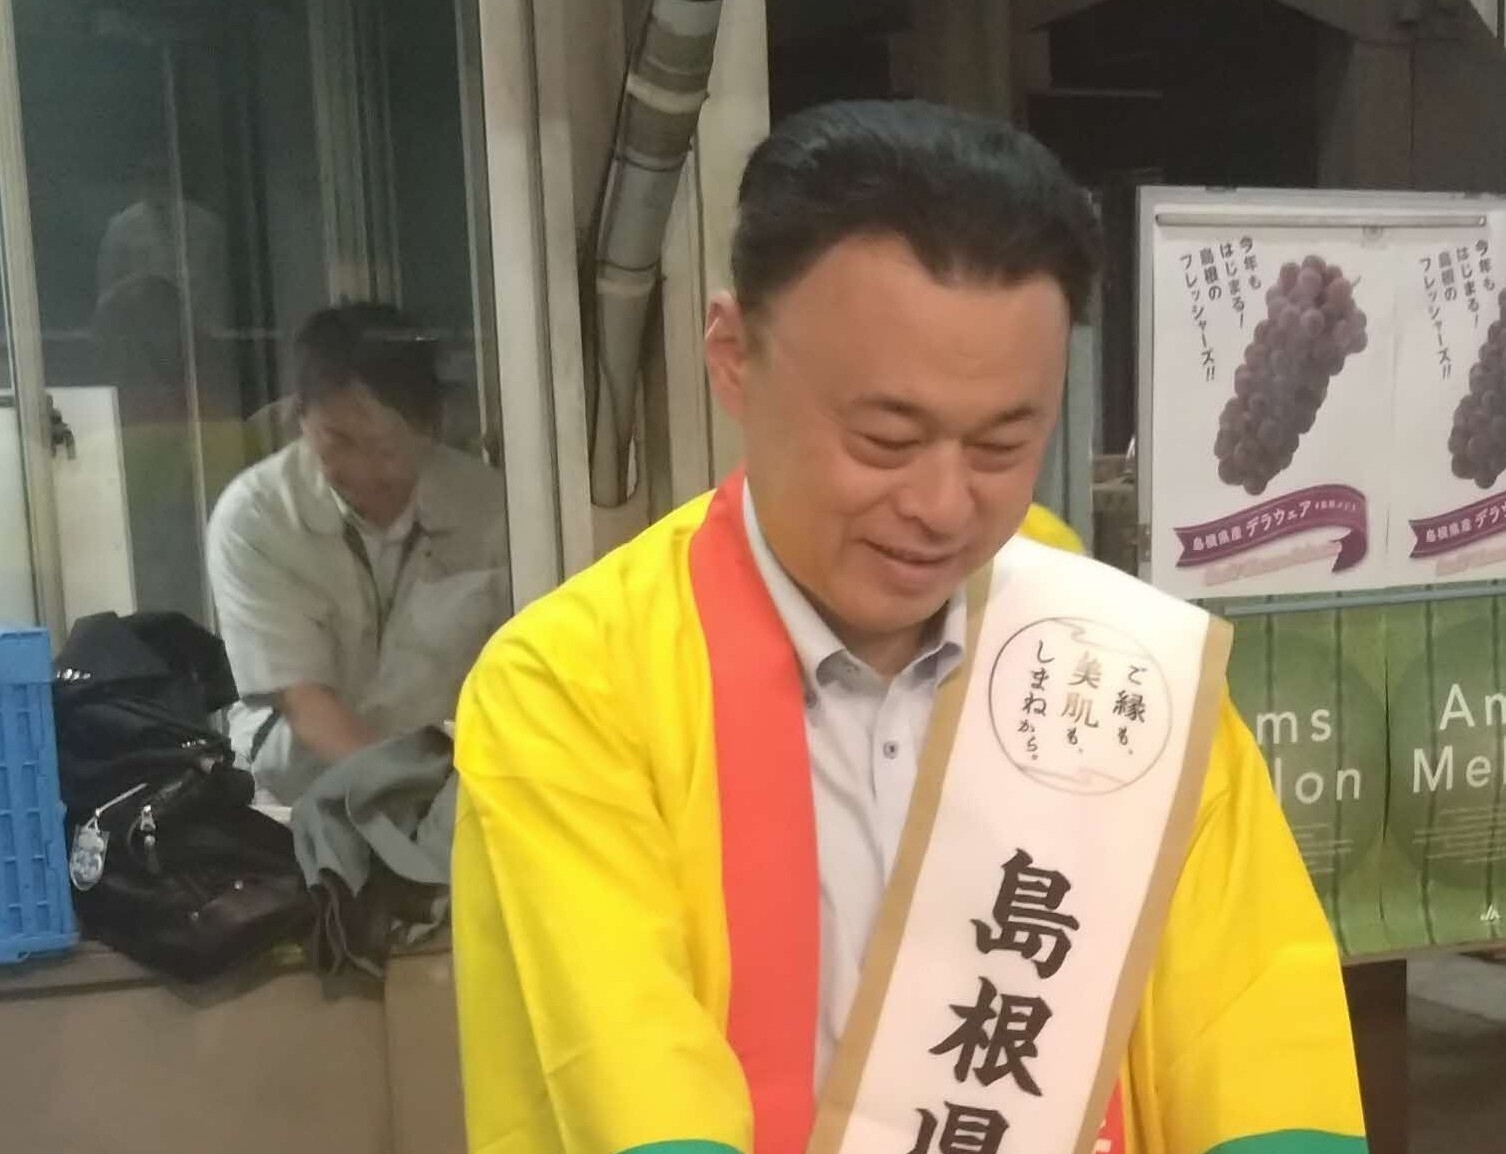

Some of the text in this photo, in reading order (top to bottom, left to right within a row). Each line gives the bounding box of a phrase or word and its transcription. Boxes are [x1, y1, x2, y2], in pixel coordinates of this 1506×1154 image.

[1246, 500, 1311, 536] デラウェア
[1256, 709, 1333, 746] ms
[1274, 757, 1362, 805] lon
